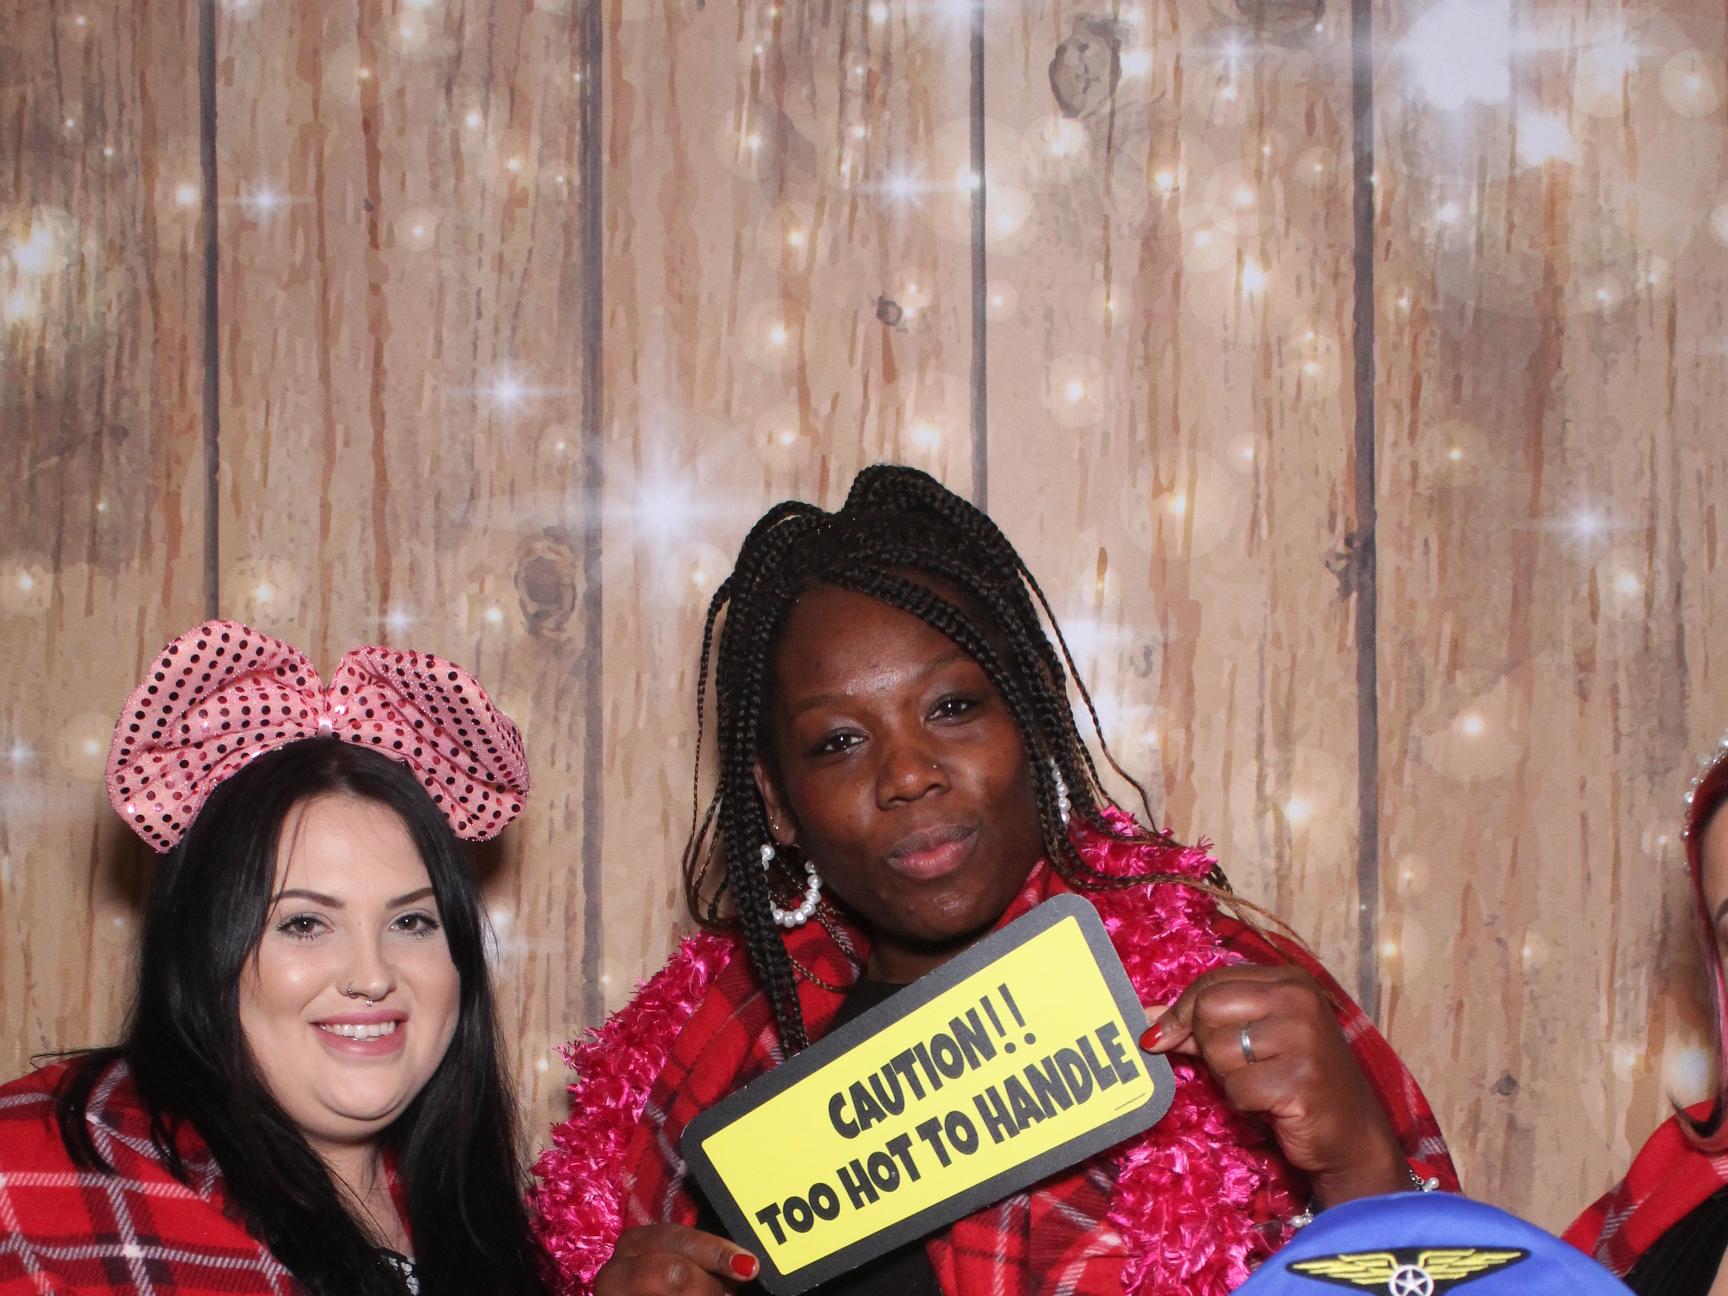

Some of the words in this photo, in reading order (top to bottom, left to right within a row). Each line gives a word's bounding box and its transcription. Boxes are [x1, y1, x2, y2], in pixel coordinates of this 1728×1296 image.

[755, 1182, 841, 1246] TOO
[836, 1132, 922, 1210] HOT
[915, 1110, 979, 1168] TO
[972, 1021, 1140, 1145] HANDLE
[828, 983, 1036, 1140] CAUTION!!
